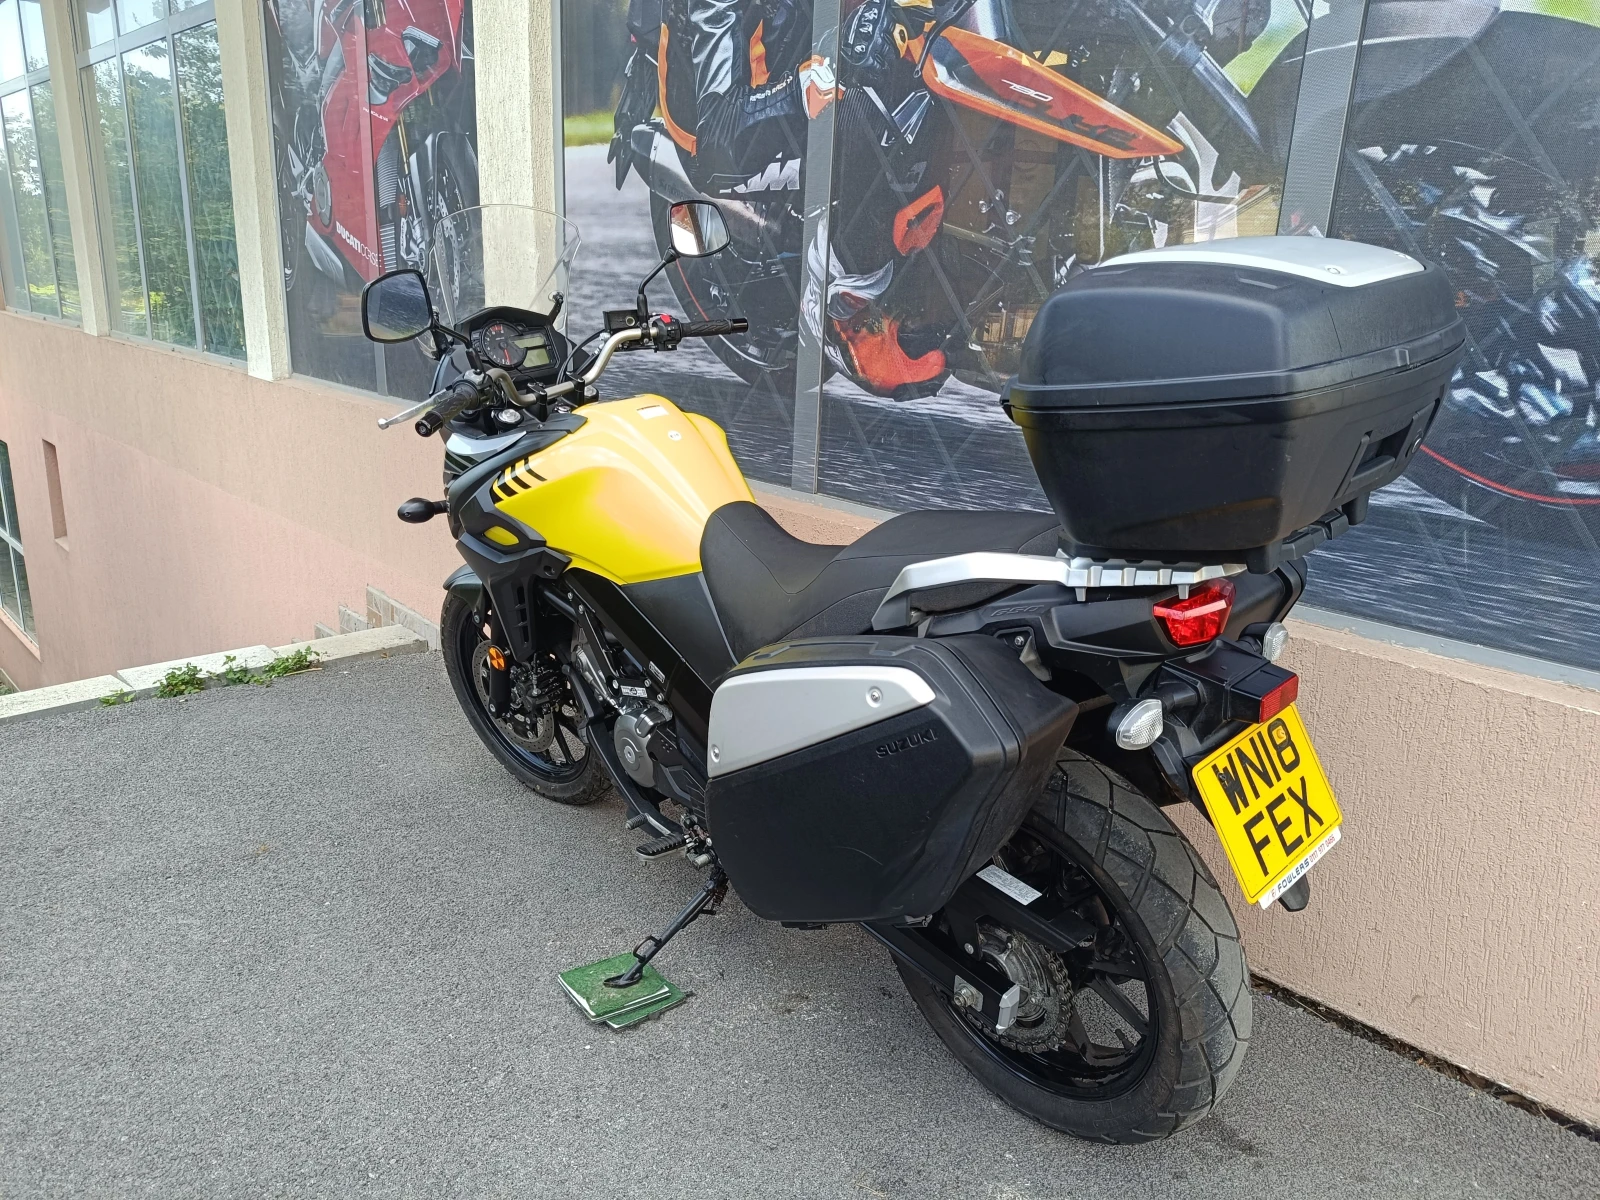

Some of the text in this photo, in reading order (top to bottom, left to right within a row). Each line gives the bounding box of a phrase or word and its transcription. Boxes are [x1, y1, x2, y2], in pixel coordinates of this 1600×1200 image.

[1001, 79, 1053, 102] 790
[876, 729, 938, 758] SUZUKI
[1211, 718, 1300, 815] WN18
[1243, 776, 1324, 877] FEX
[1277, 858, 1310, 892] FOWLERS
